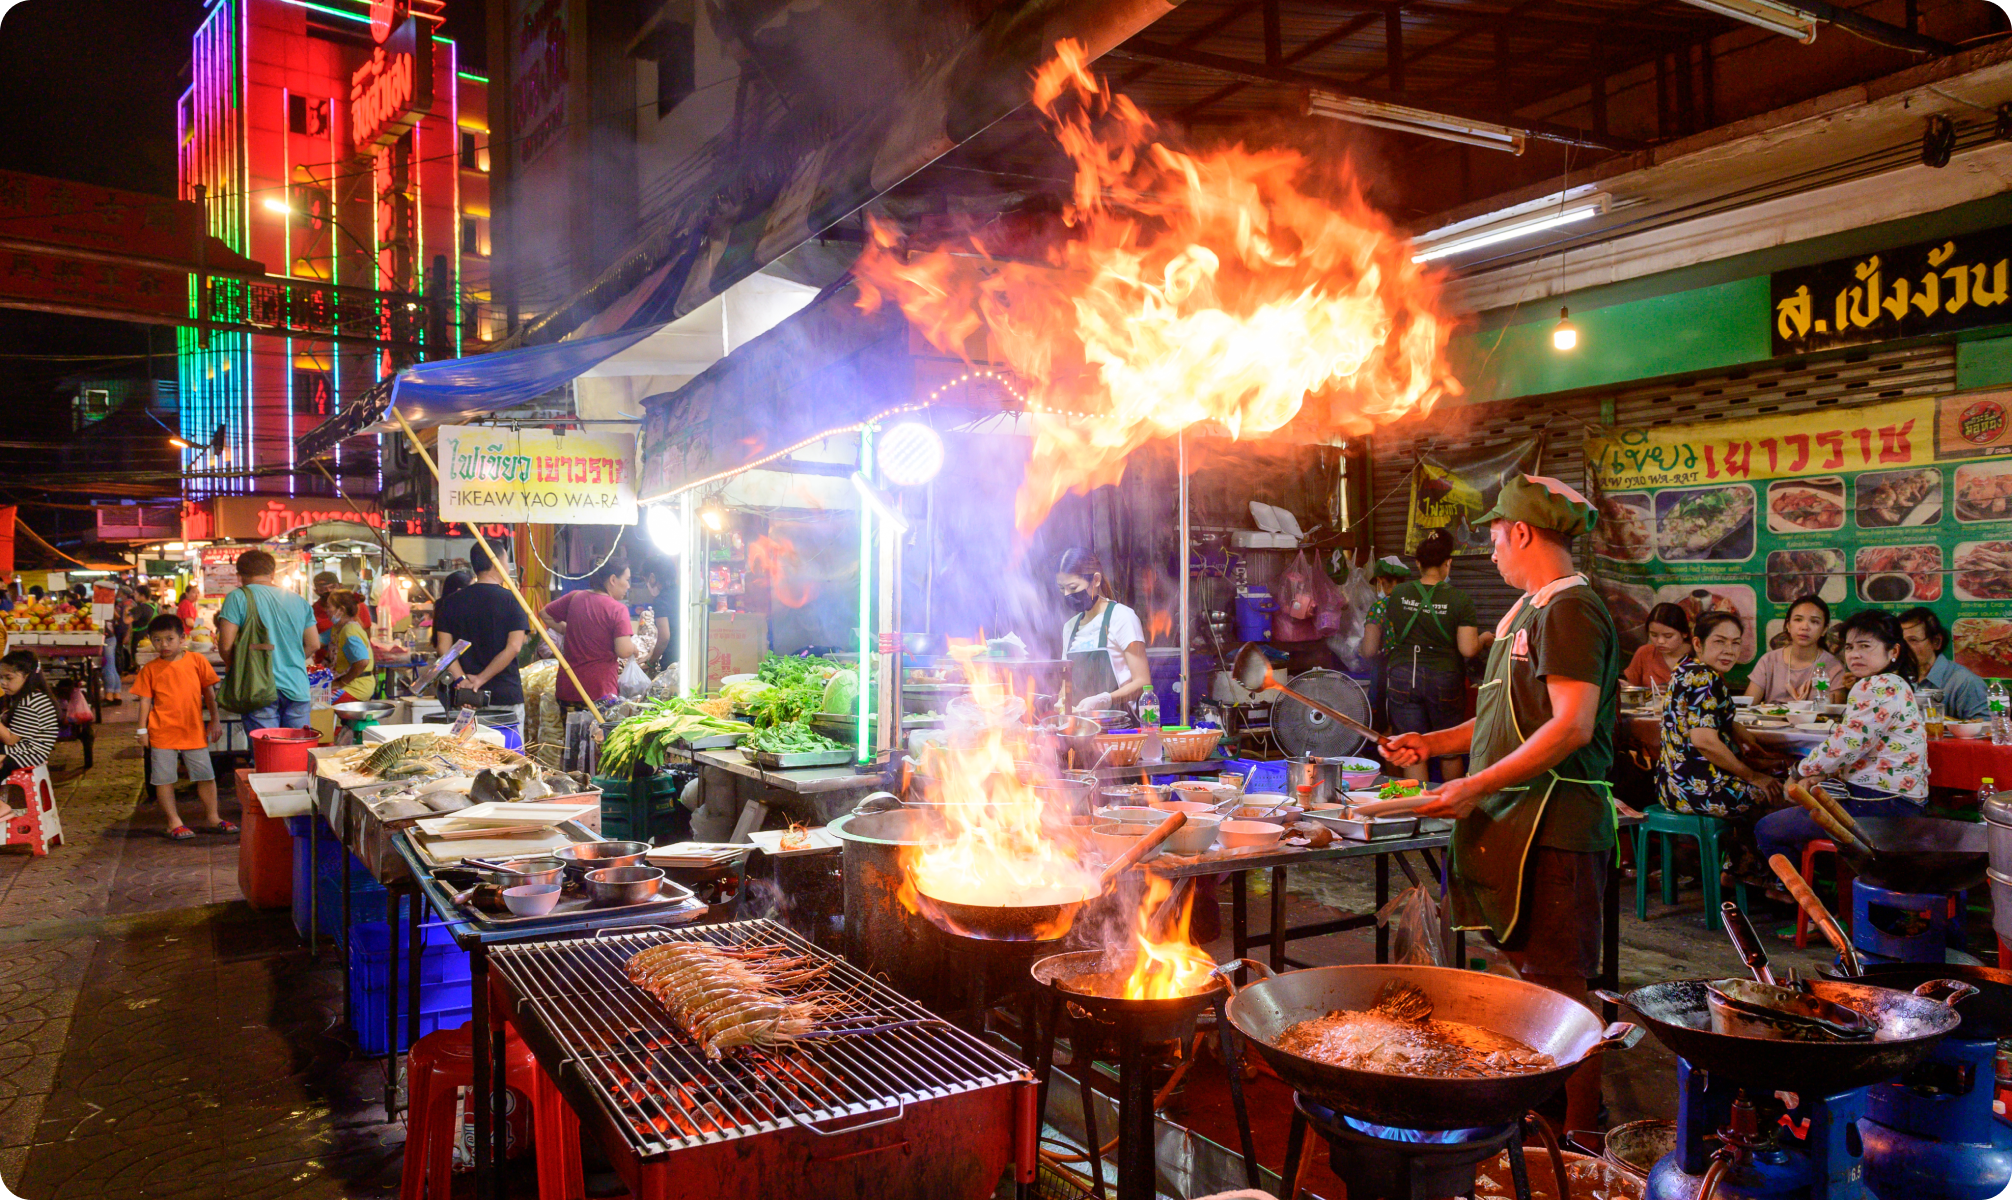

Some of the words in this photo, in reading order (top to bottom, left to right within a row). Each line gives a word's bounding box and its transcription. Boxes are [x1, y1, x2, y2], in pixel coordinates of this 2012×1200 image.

[1776, 240, 2010, 341] ส.เป้งง้วน
[446, 438, 532, 483] ไฟเขียว
[1704, 418, 1916, 479] เยาวราช
[1625, 475, 1646, 489] YAO
[1648, 472, 1699, 485] WA-RAT
[449, 490, 515, 507] FIKEAW
[520, 491, 559, 508] YAO
[564, 492, 622, 509] WA-RA
[1701, 565, 1726, 574] Snapper
